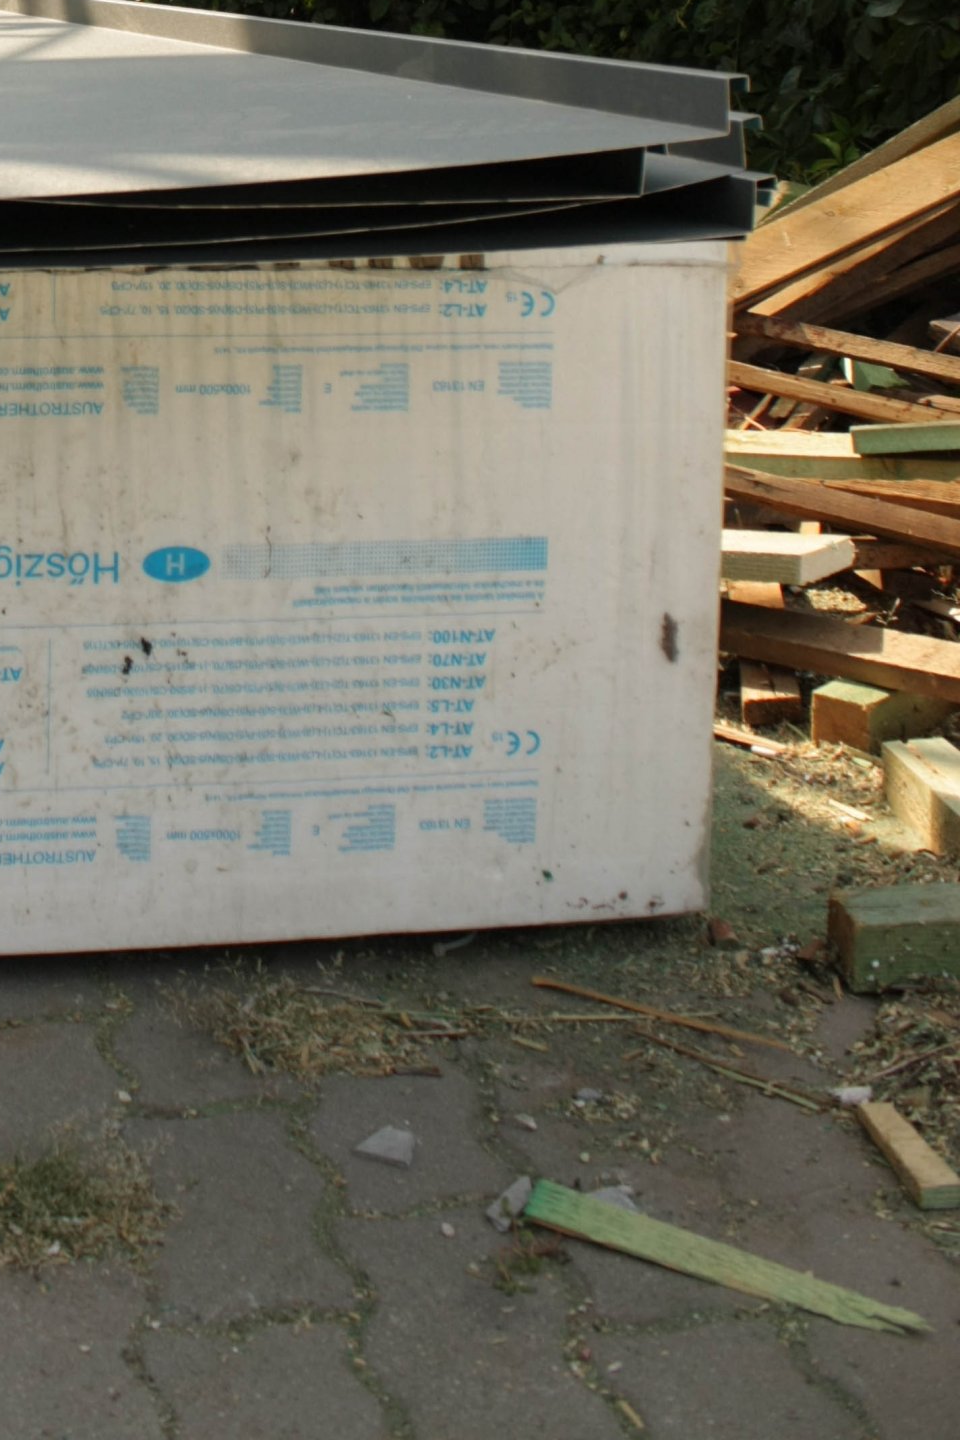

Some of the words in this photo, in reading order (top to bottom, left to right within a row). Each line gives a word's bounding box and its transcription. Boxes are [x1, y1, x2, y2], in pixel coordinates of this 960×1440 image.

[440, 279, 488, 292] AT-L4:
[439, 302, 487, 317] AT-L2:
[176, 384, 196, 394] mm
[199, 382, 252, 395] 1000x500
[324, 382, 332, 394] E
[468, 380, 484, 392] EN
[428, 628, 496, 642] AT-N100:
[428, 651, 486, 666] AT-N70:
[427, 674, 486, 689] AT-N30:
[426, 697, 475, 712] AT-L5:
[426, 720, 474, 735] AT-L4:
[425, 744, 474, 758] AT-L2:
[454, 818, 470, 831] EN
[167, 830, 187, 840] mm
